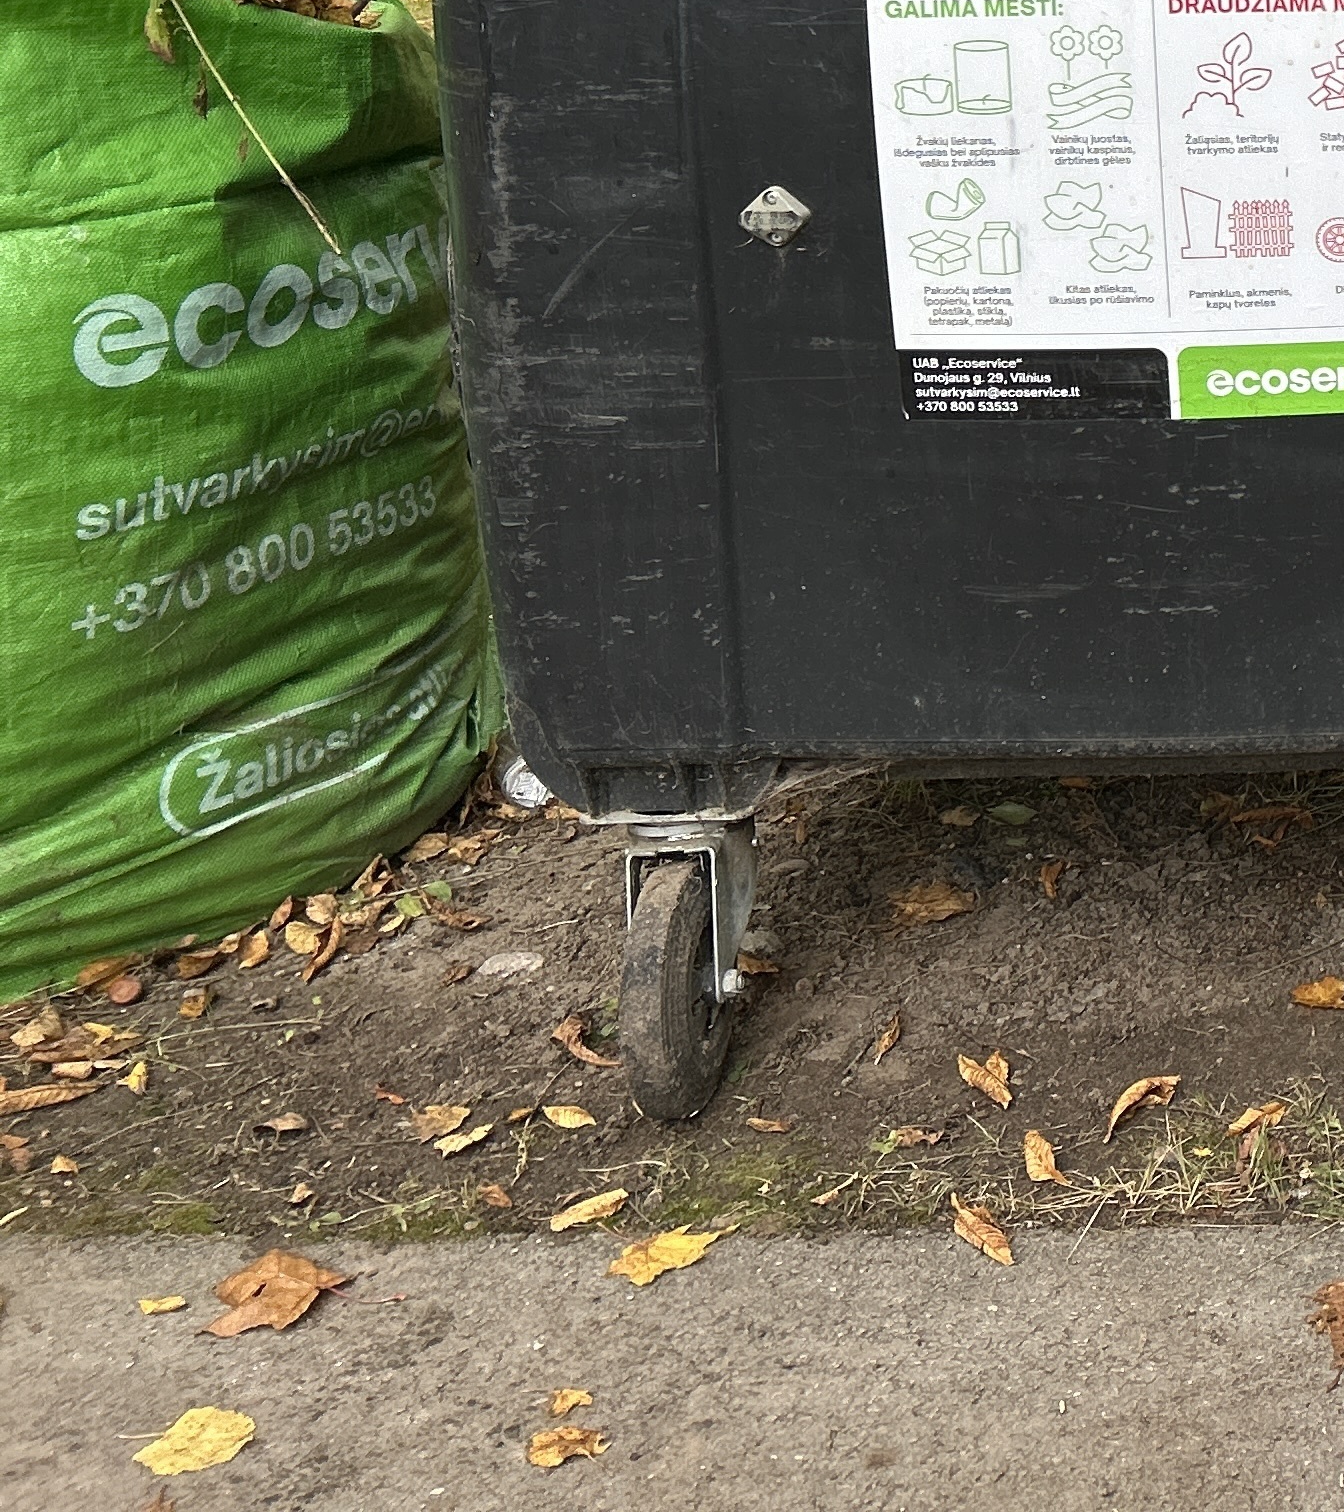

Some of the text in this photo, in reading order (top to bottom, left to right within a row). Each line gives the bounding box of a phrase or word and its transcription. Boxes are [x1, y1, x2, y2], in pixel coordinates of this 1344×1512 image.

[885, 0, 979, 18] GALIMA
[1052, 135, 1131, 145] Vainikų juostas,
[950, 148, 966, 156] bei
[1048, 146, 1136, 156] vainikų kaspinus,
[1187, 145, 1278, 156] tvarkymo atliekas
[1322, 143, 1328, 151] ir
[1055, 156, 1130, 166] dirbtines gėles
[924, 286, 969, 297] Pakuočių
[1066, 285, 1090, 293] Kitas
[1190, 288, 1292, 300] Paminklus, akmenis,
[1090, 296, 1103, 306] po
[1106, 295, 1154, 304] rūšiavimo
[1206, 300, 1276, 310] kapų tvoreles
[913, 358, 939, 368] UAB
[914, 373, 1051, 385] Dunojaus g. 29, Vilnius
[916, 387, 1080, 399] sutvarkysim@ecoservice.lt
[917, 401, 1018, 412] +370 800 53533
[71, 475, 437, 640] +370 800 53533
